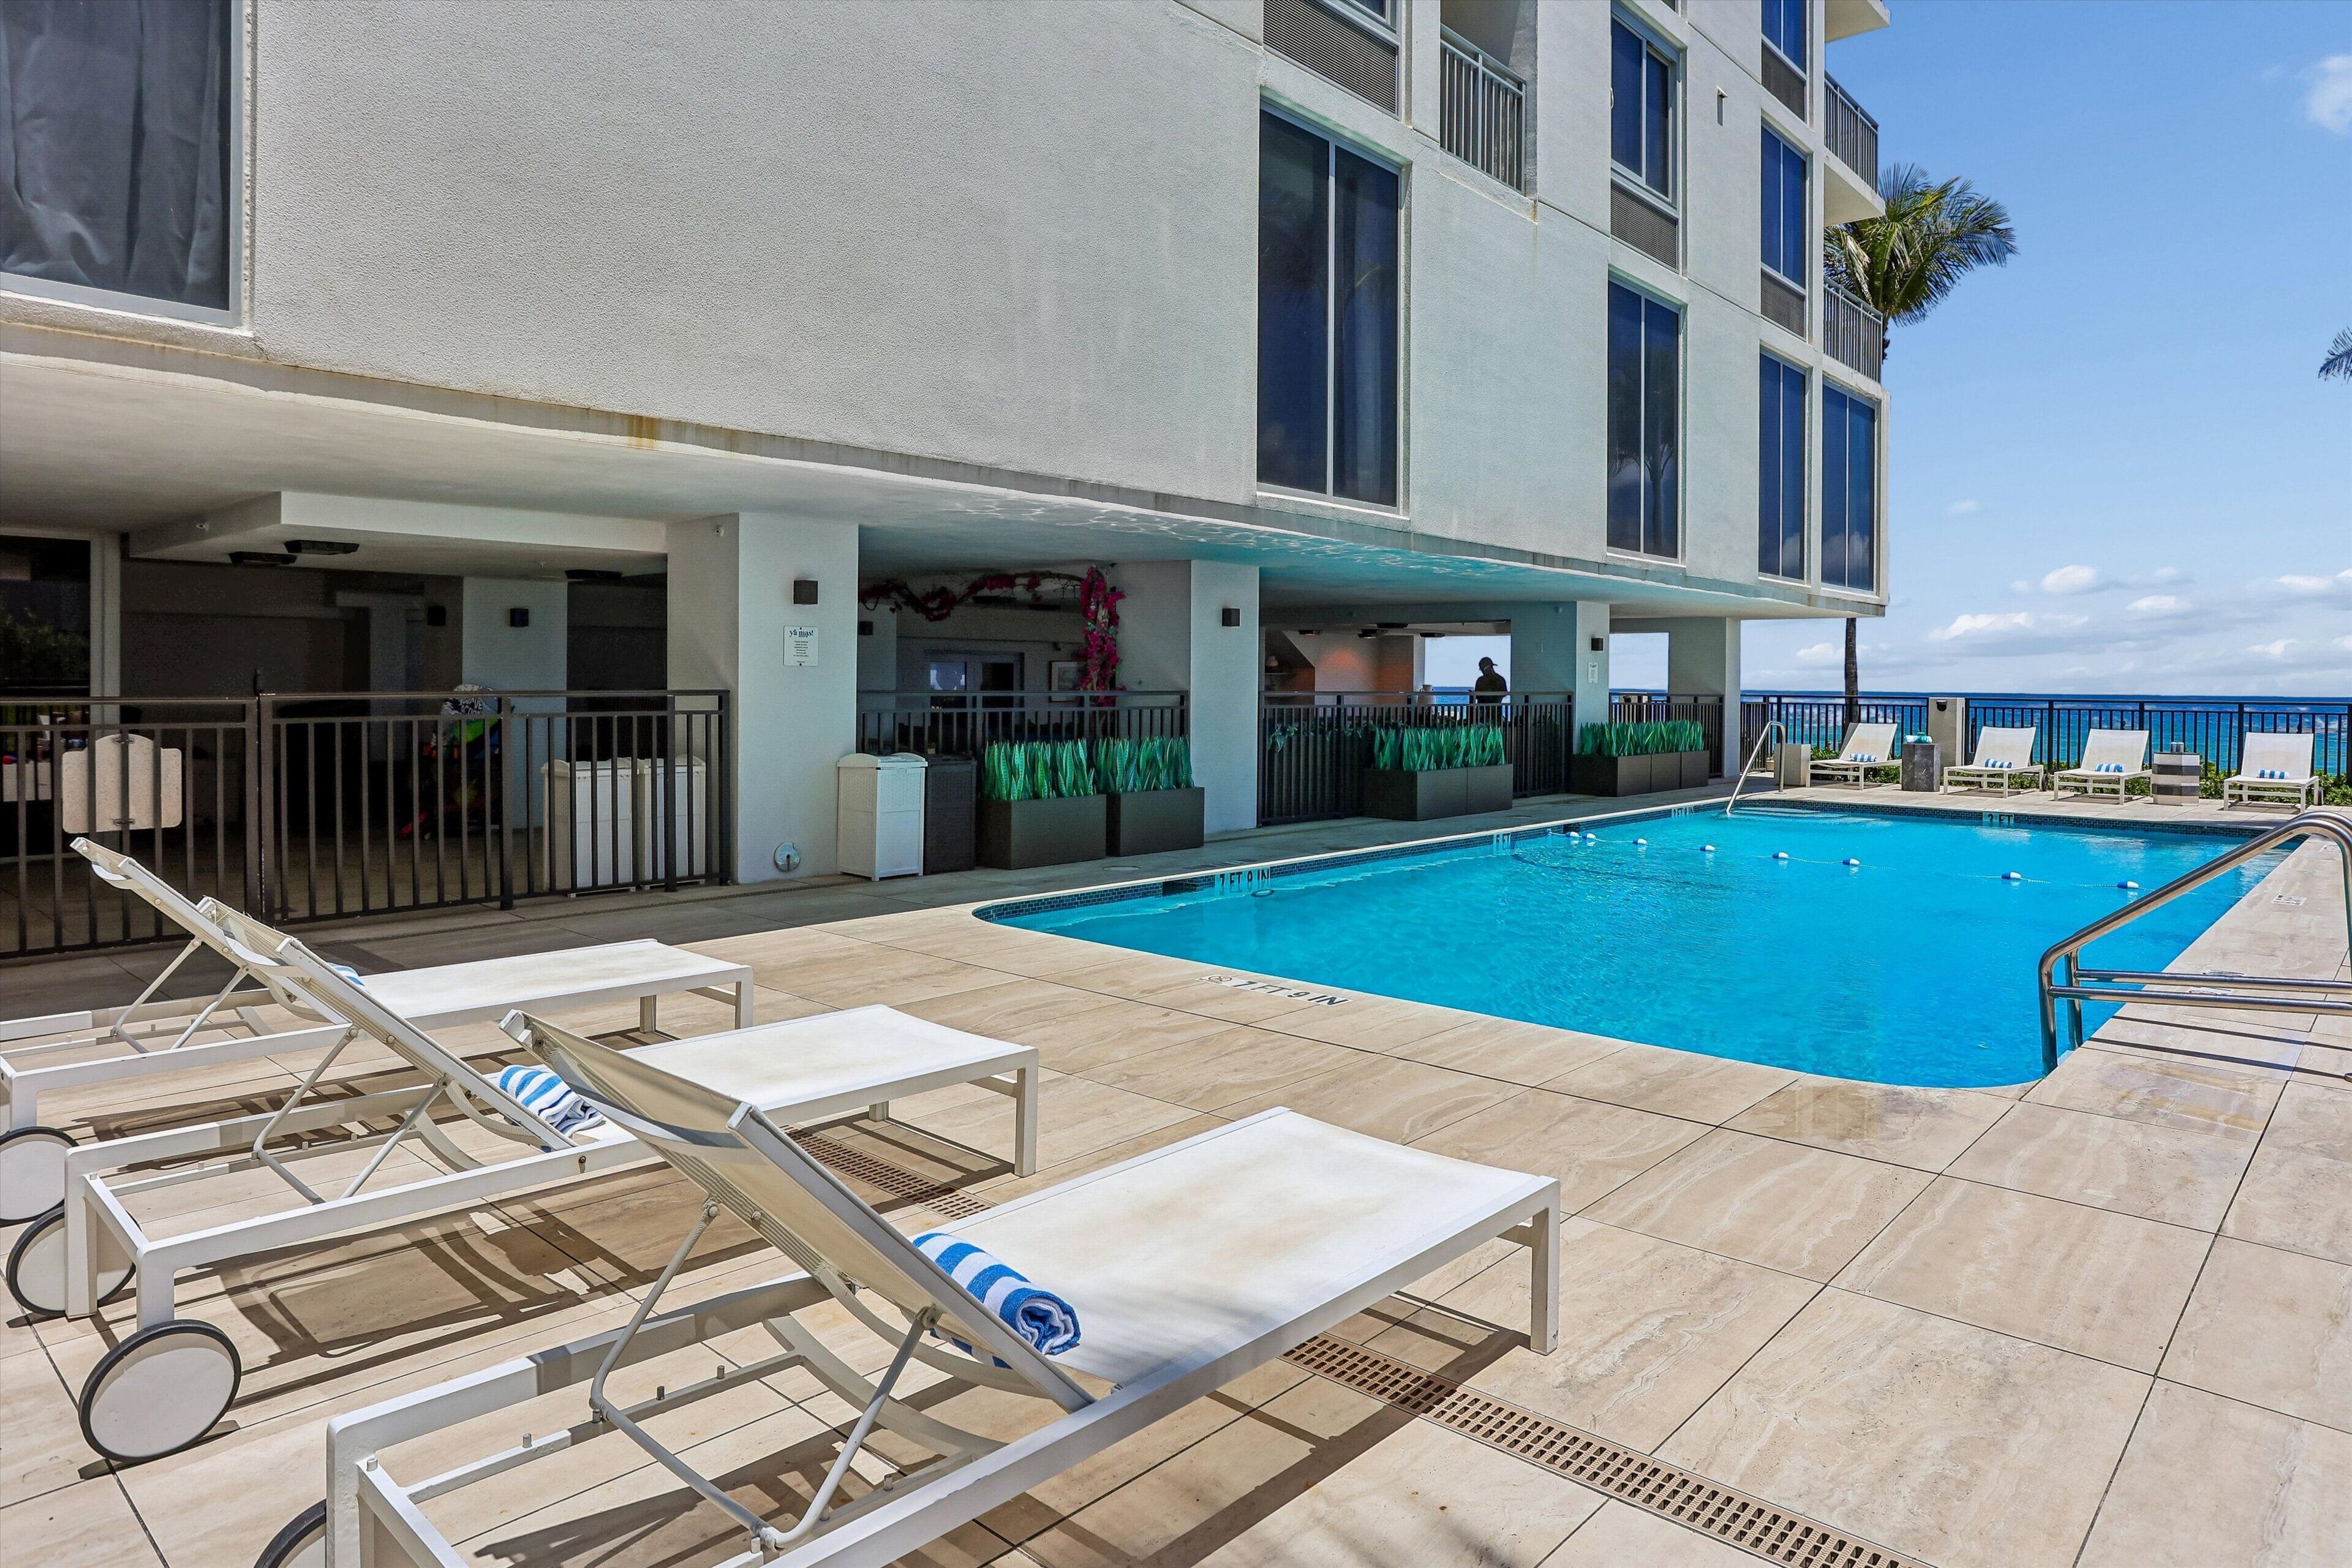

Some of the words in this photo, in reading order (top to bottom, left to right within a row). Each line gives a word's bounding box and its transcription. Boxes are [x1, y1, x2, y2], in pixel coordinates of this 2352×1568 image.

[1229, 872, 1243, 885] FT
[1257, 868, 1270, 881] IN
[1250, 984, 1292, 993] FT
[1307, 995, 1349, 1006] IN
